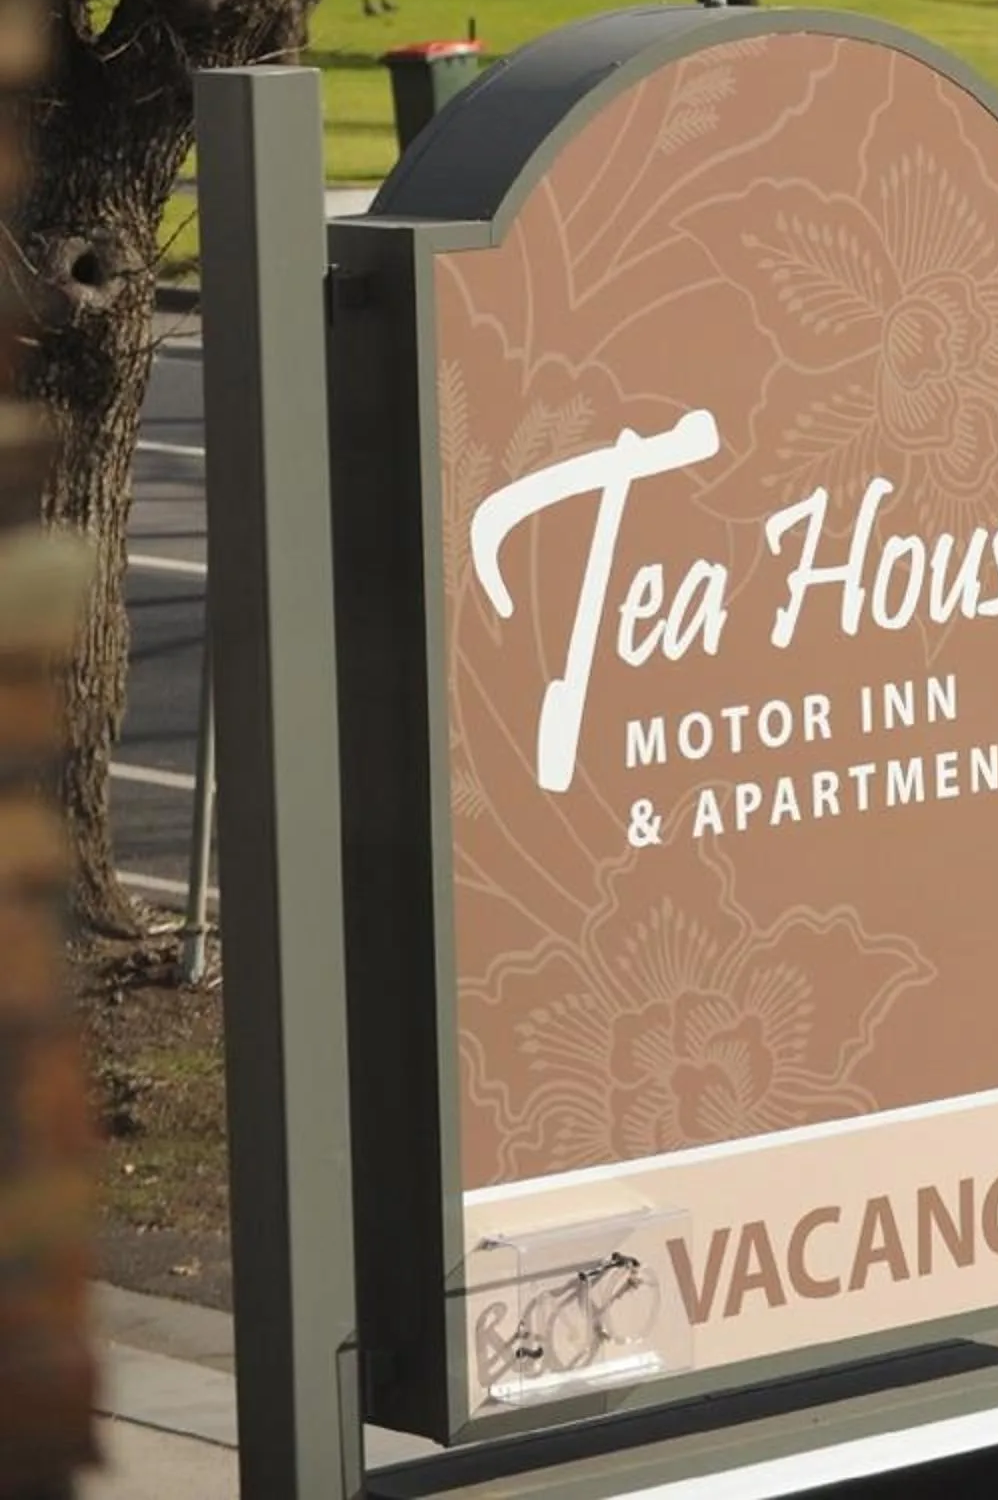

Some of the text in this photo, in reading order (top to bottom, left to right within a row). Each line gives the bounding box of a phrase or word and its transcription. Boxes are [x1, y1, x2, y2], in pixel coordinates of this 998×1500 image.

[471, 409, 728, 792] Tea
[625, 674, 957, 768] MOTOR INN
[627, 799, 663, 848] &
